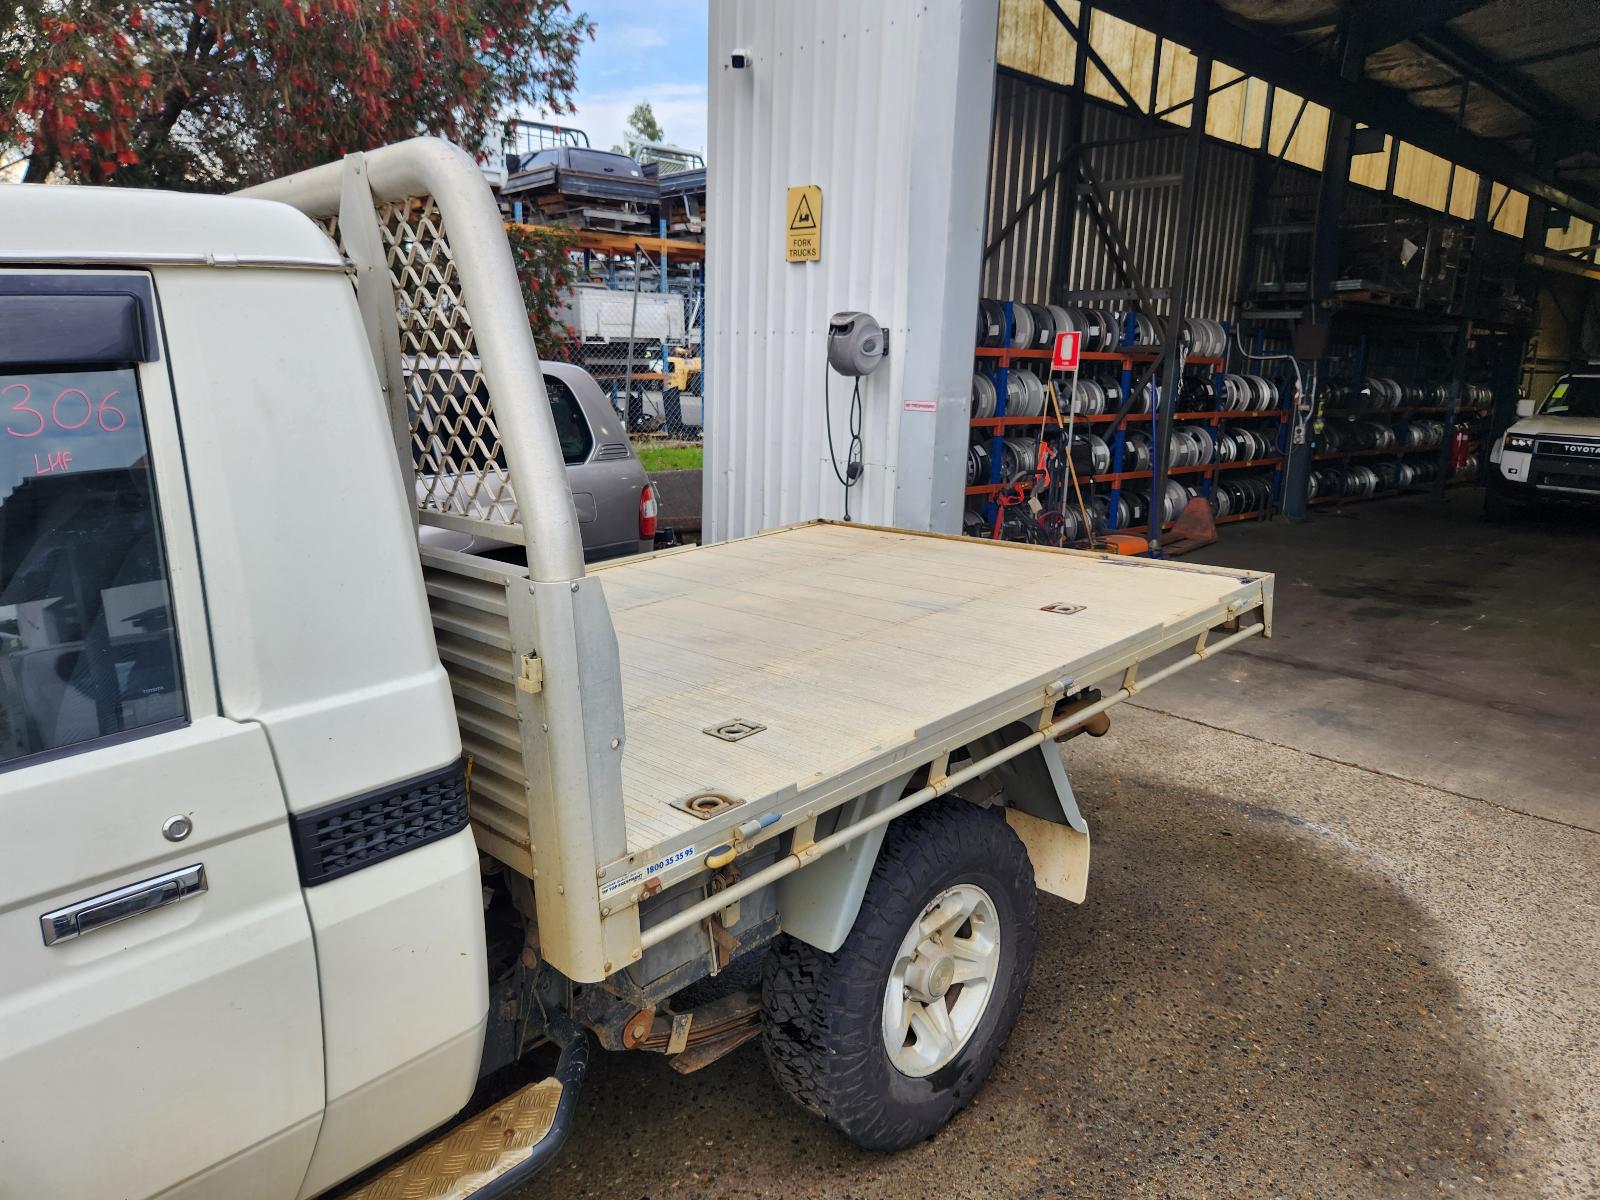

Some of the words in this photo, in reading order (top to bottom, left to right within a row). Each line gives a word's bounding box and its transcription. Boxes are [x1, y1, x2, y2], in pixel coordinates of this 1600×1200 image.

[789, 248, 817, 257] TRUCKS
[1, 383, 126, 437] 306
[1564, 445, 1600, 454] TOYOTA
[646, 861, 664, 875] 1800
[665, 856, 674, 866] 35
[675, 852, 684, 861] 35
[684, 848, 694, 857] 95
